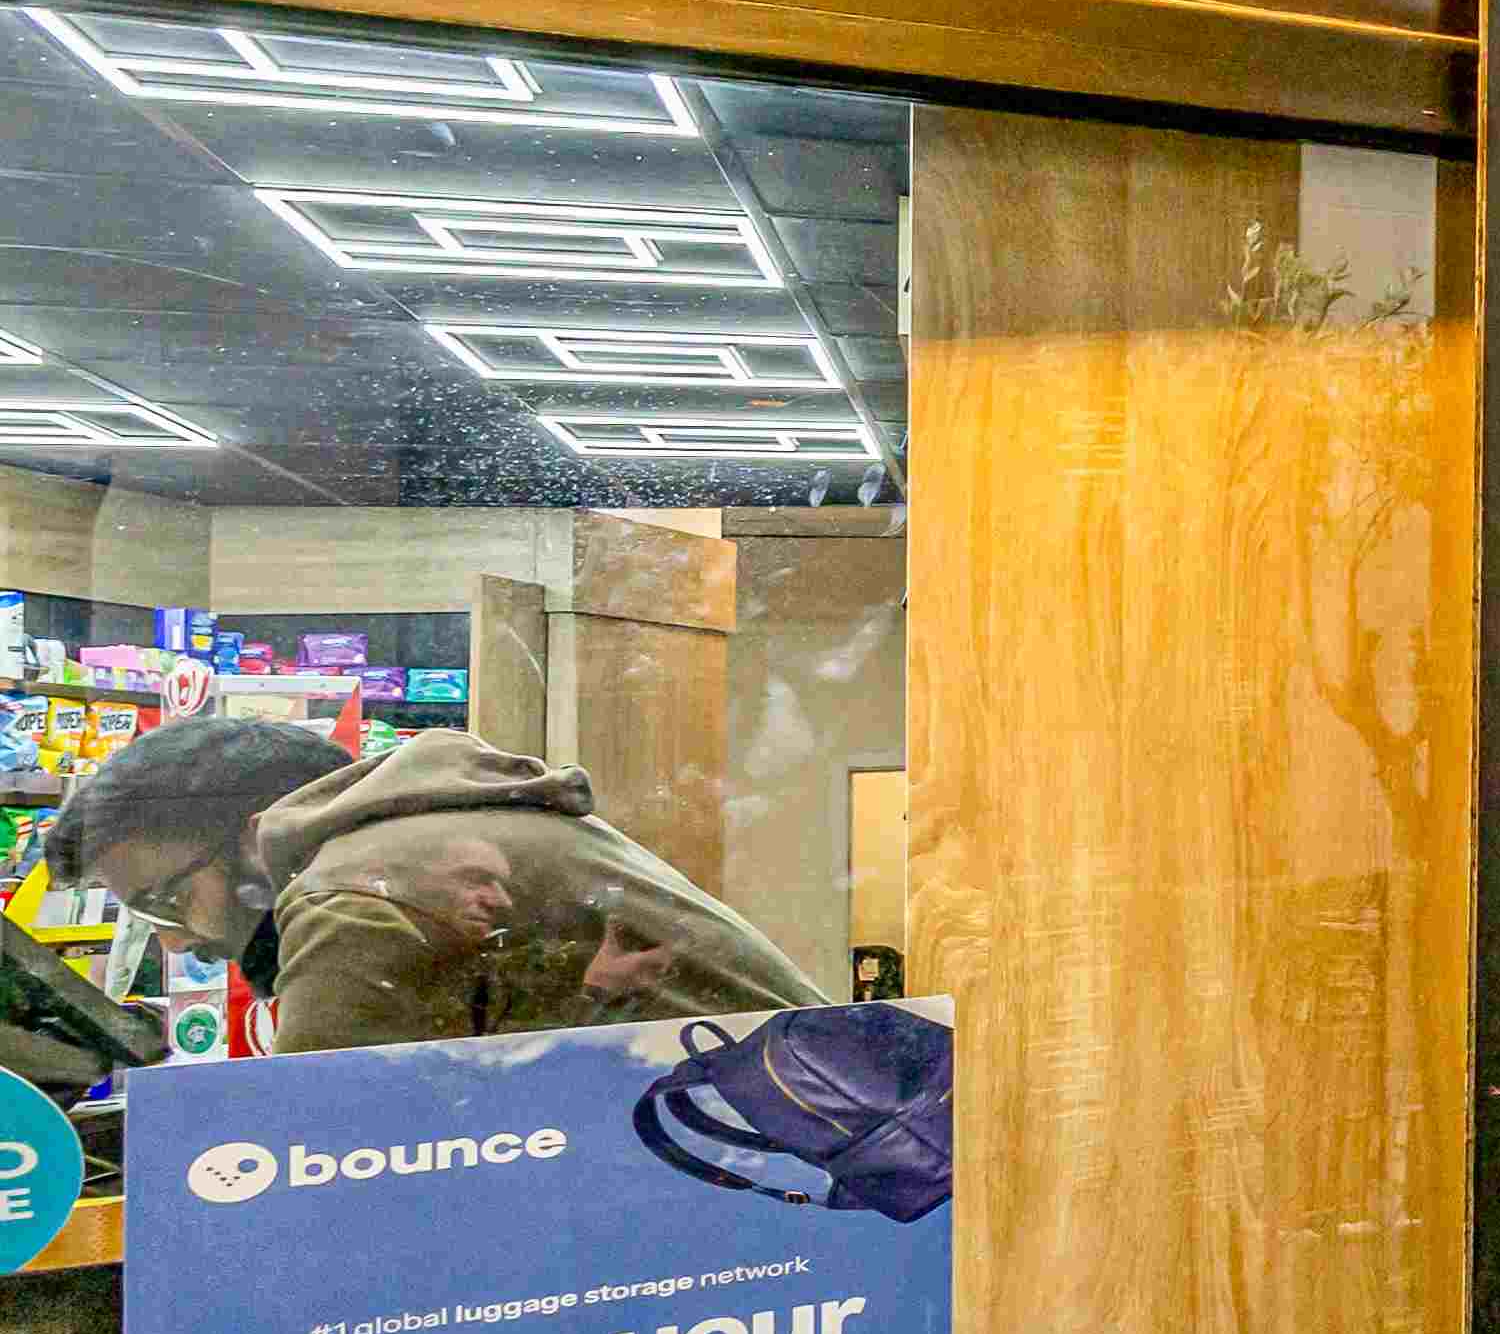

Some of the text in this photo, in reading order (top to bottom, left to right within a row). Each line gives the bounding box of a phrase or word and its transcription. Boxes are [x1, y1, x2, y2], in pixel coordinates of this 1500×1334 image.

[289, 1127, 568, 1187] bounce
[455, 1290, 578, 1326] luggage
[584, 1272, 694, 1308] storage
[700, 1255, 810, 1287] network
